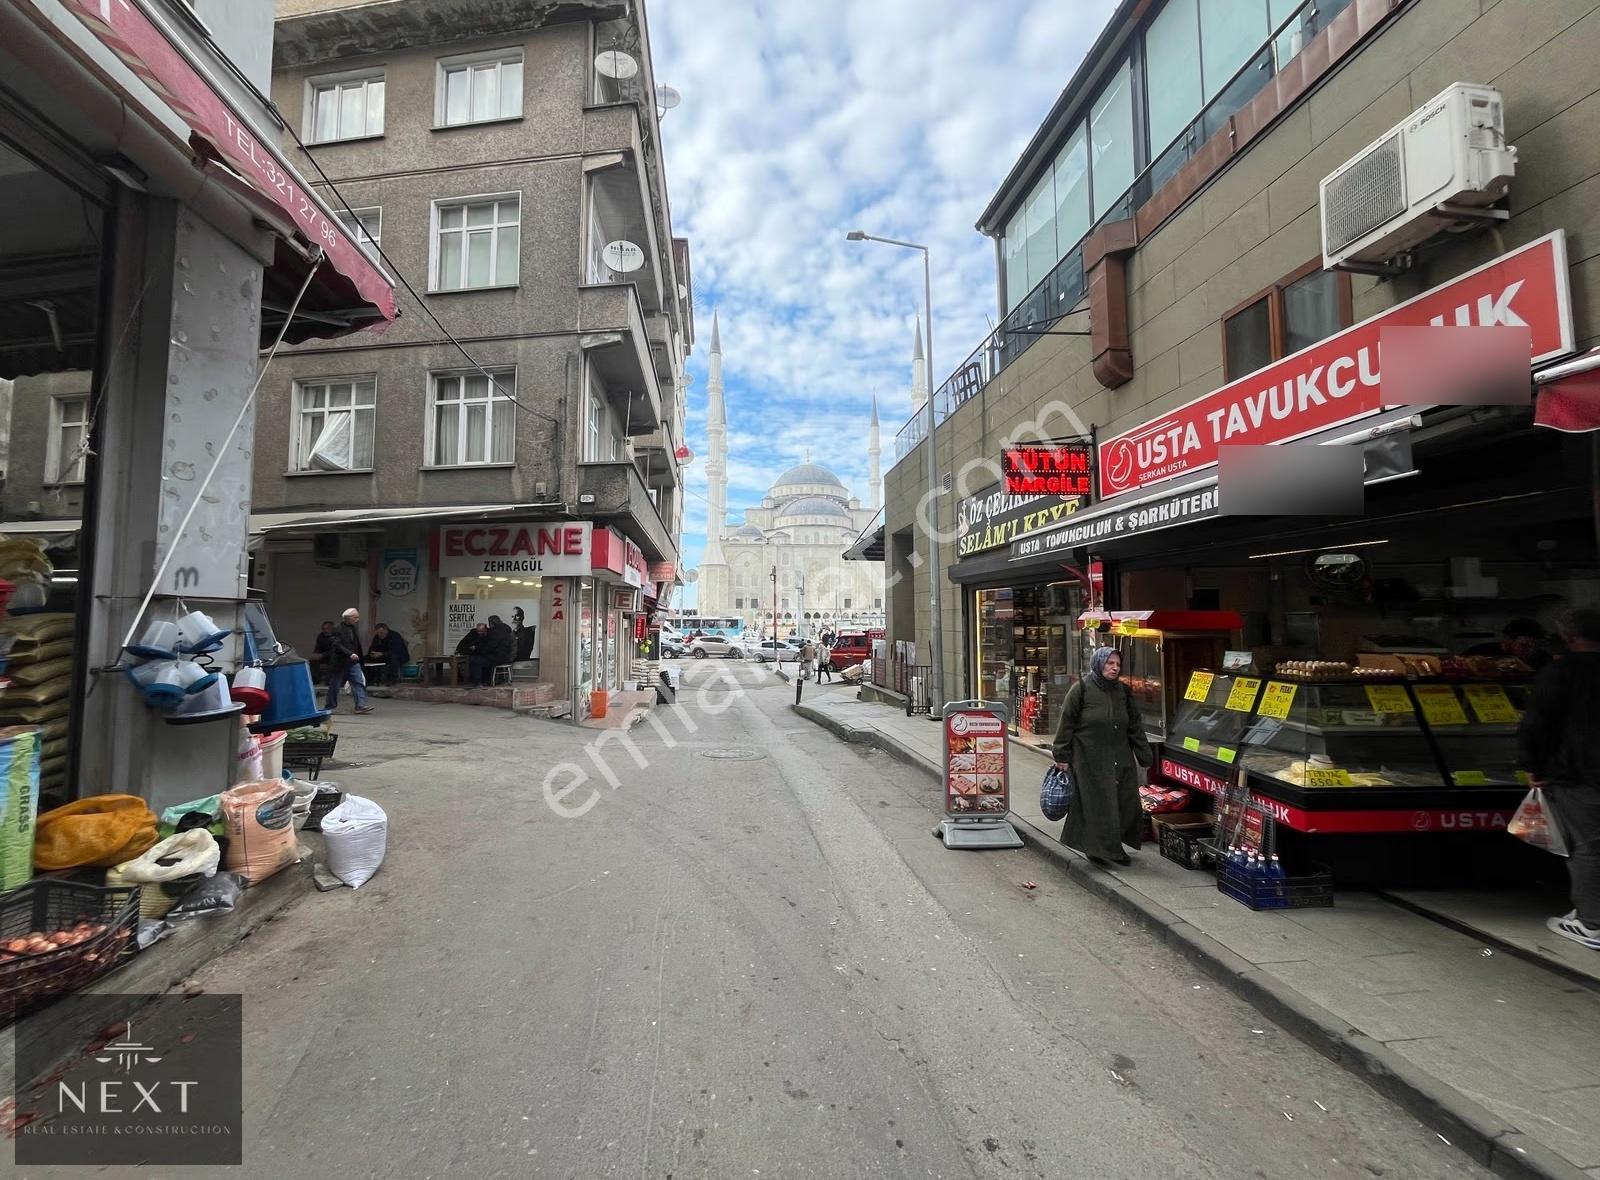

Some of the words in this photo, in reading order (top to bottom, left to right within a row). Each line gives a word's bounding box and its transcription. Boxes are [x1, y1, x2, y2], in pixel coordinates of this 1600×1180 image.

[1419, 104, 1446, 126] BOSCH
[222, 110, 294, 204] TEL:321
[299, 197, 318, 224] 27
[320, 220, 337, 248] 96
[1136, 421, 1202, 469] USTA
[1206, 279, 1529, 444] TAVUKCUK
[1006, 449, 1086, 471] TÜTÜN
[1138, 466, 1167, 482] SERKAN
[1167, 459, 1188, 473] USTA
[1005, 474, 1089, 492] NARGİLE
[969, 496, 983, 526] ÖZ
[445, 527, 583, 557] ECZANE
[1020, 538, 1040, 555] USTA
[1045, 517, 1112, 549] TAVUKCULUK
[1115, 515, 1125, 532] &
[388, 564, 412, 577] Gaz
[483, 557, 543, 572] ZEHRAGÜL
[388, 581, 410, 591] son
[617, 593, 631, 608] E
[1173, 765, 1202, 787] USTA
[18, 784, 31, 834] GRASS
[1440, 812, 1506, 829] USTA
